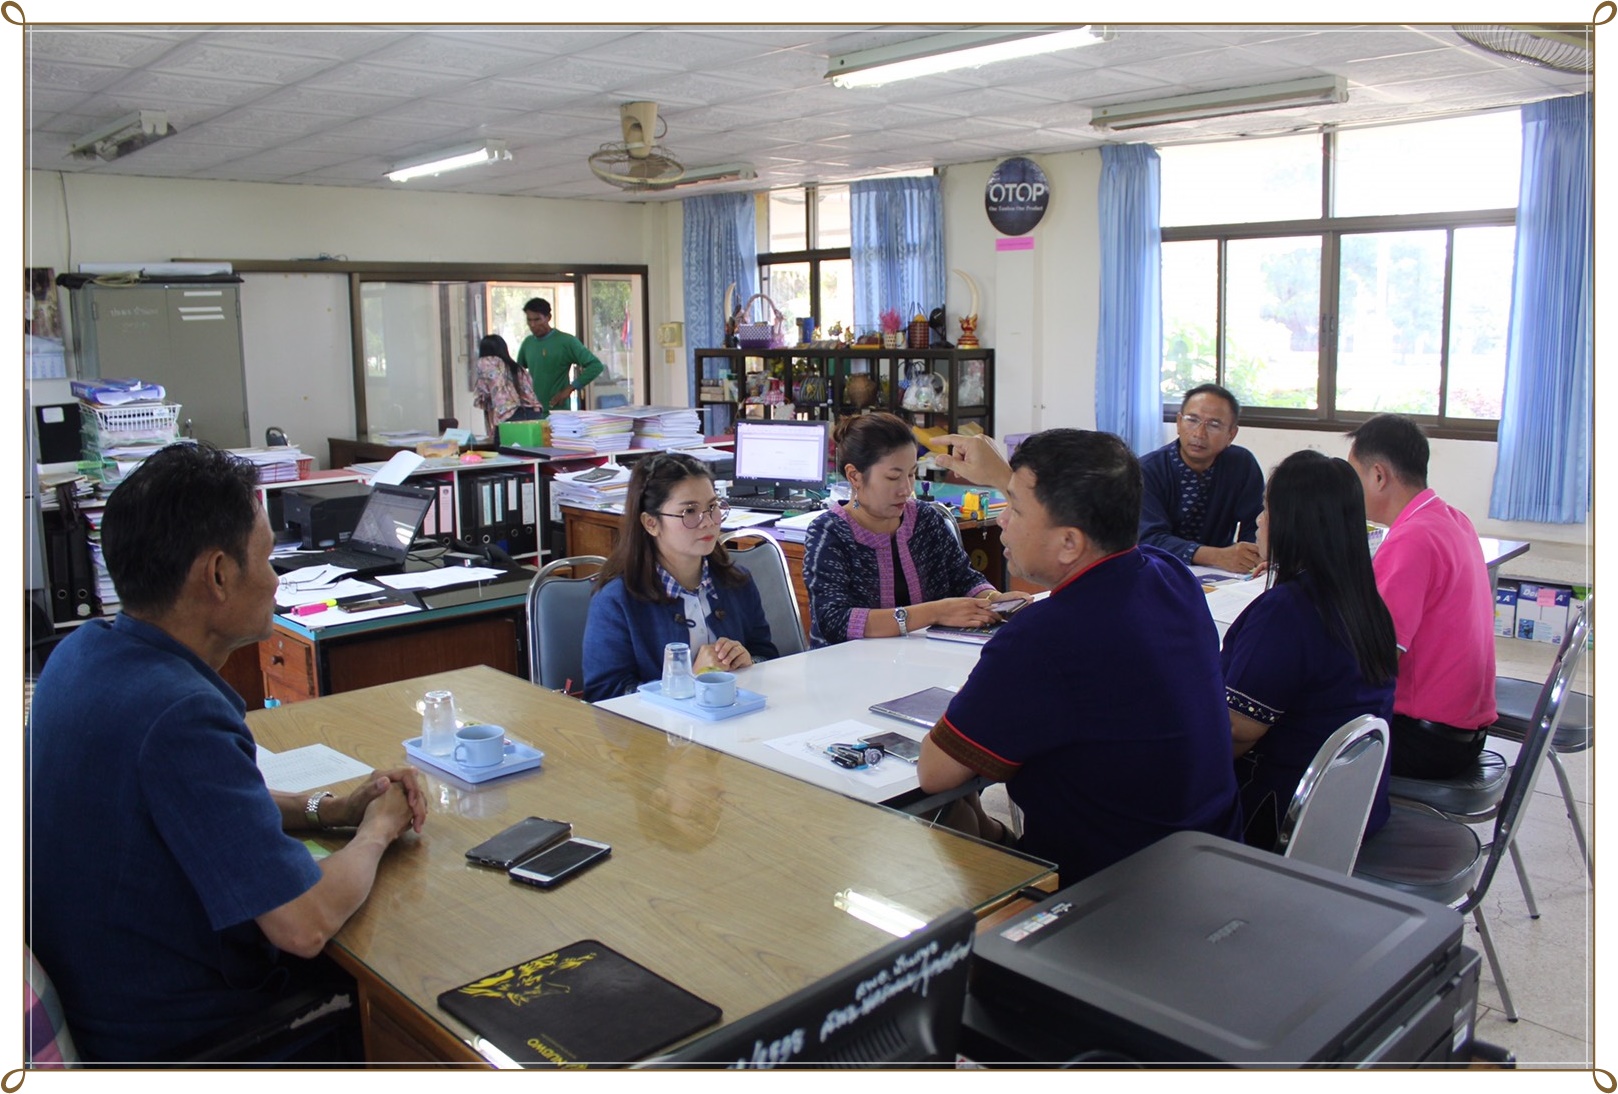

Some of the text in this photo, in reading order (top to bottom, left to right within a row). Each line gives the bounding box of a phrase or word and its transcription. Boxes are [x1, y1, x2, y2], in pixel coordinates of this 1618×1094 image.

[989, 183, 1045, 202] OTOP
[1502, 594, 1510, 602] A
[1556, 594, 1564, 602] A
